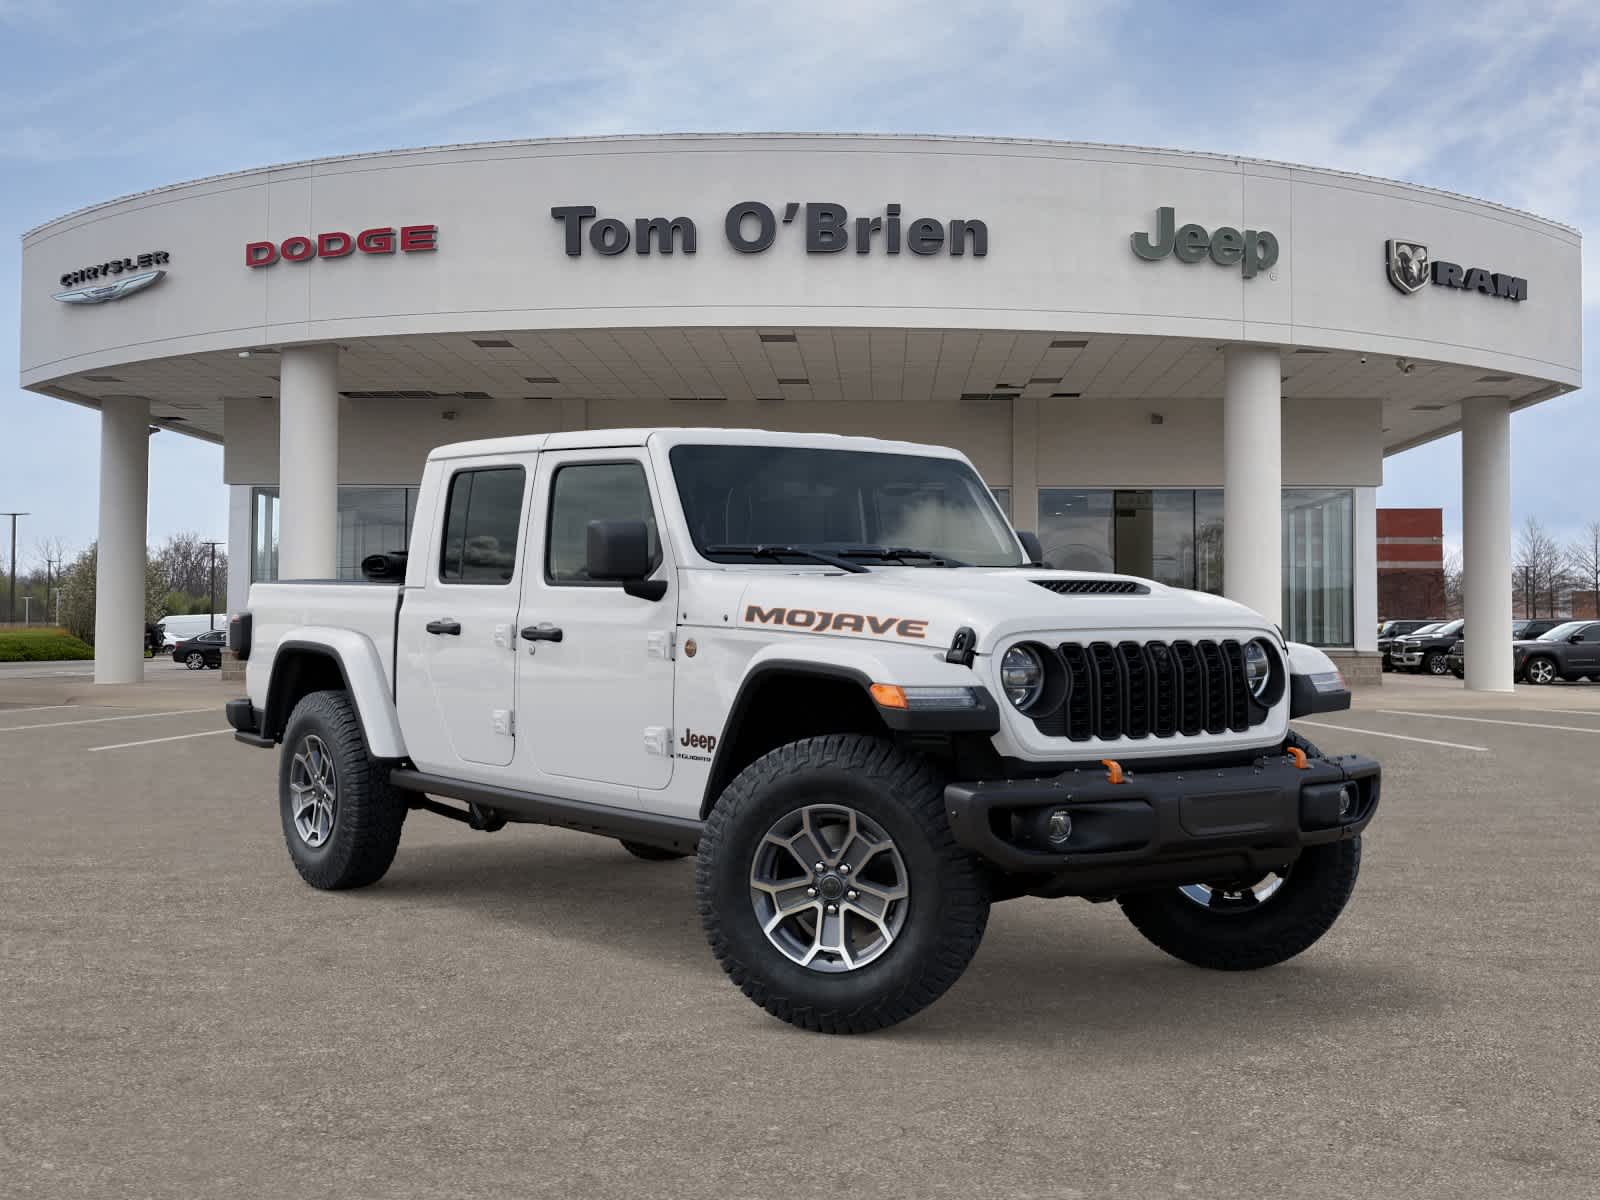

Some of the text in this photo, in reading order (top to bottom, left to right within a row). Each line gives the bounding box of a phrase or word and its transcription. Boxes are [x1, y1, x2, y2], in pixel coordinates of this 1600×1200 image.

[245, 224, 439, 269] DODGE
[551, 201, 989, 257] Tom O'Brien
[1130, 206, 1280, 279] Jeep
[60, 250, 170, 287] CHRYSLER
[1431, 260, 1528, 302] RAM
[744, 604, 929, 639] MOJAVE
[680, 727, 717, 754] Jeep
